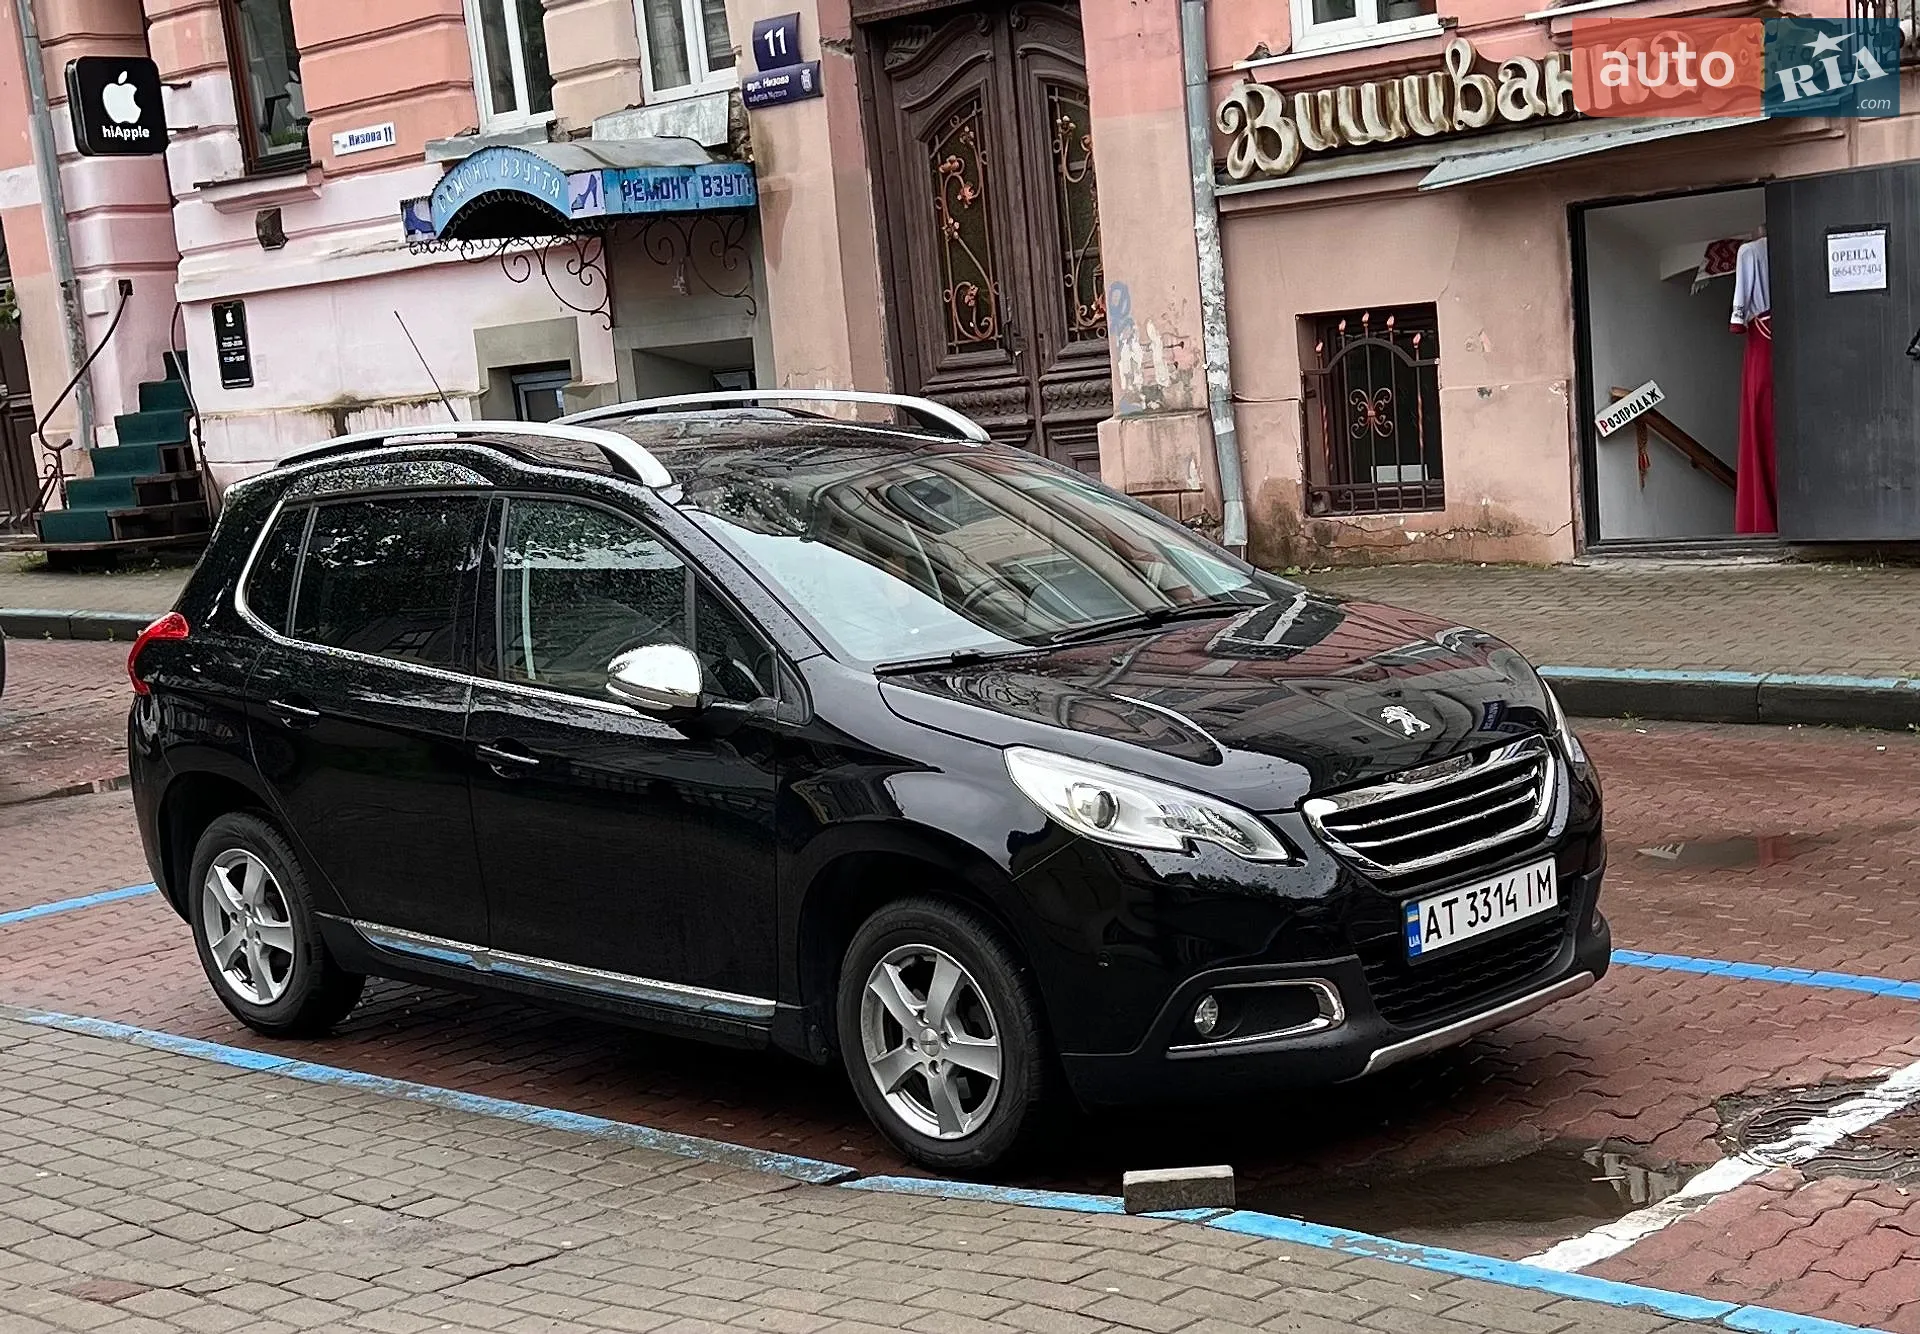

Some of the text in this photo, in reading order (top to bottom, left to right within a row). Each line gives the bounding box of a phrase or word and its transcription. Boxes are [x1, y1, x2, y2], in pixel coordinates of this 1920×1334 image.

[763, 26, 787, 57] 11
[102, 125, 150, 141] hiApple
[348, 126, 393, 147] Низова 11
[501, 157, 562, 201] ВЗУТТЯ
[621, 175, 691, 202] РЕМОНТ
[1831, 248, 1877, 263] ОРЕНДА
[1599, 387, 1661, 433] РОЗПРОДАЖ
[1424, 864, 1552, 944] AT 3314 IM
[1408, 935, 1421, 948] UA
